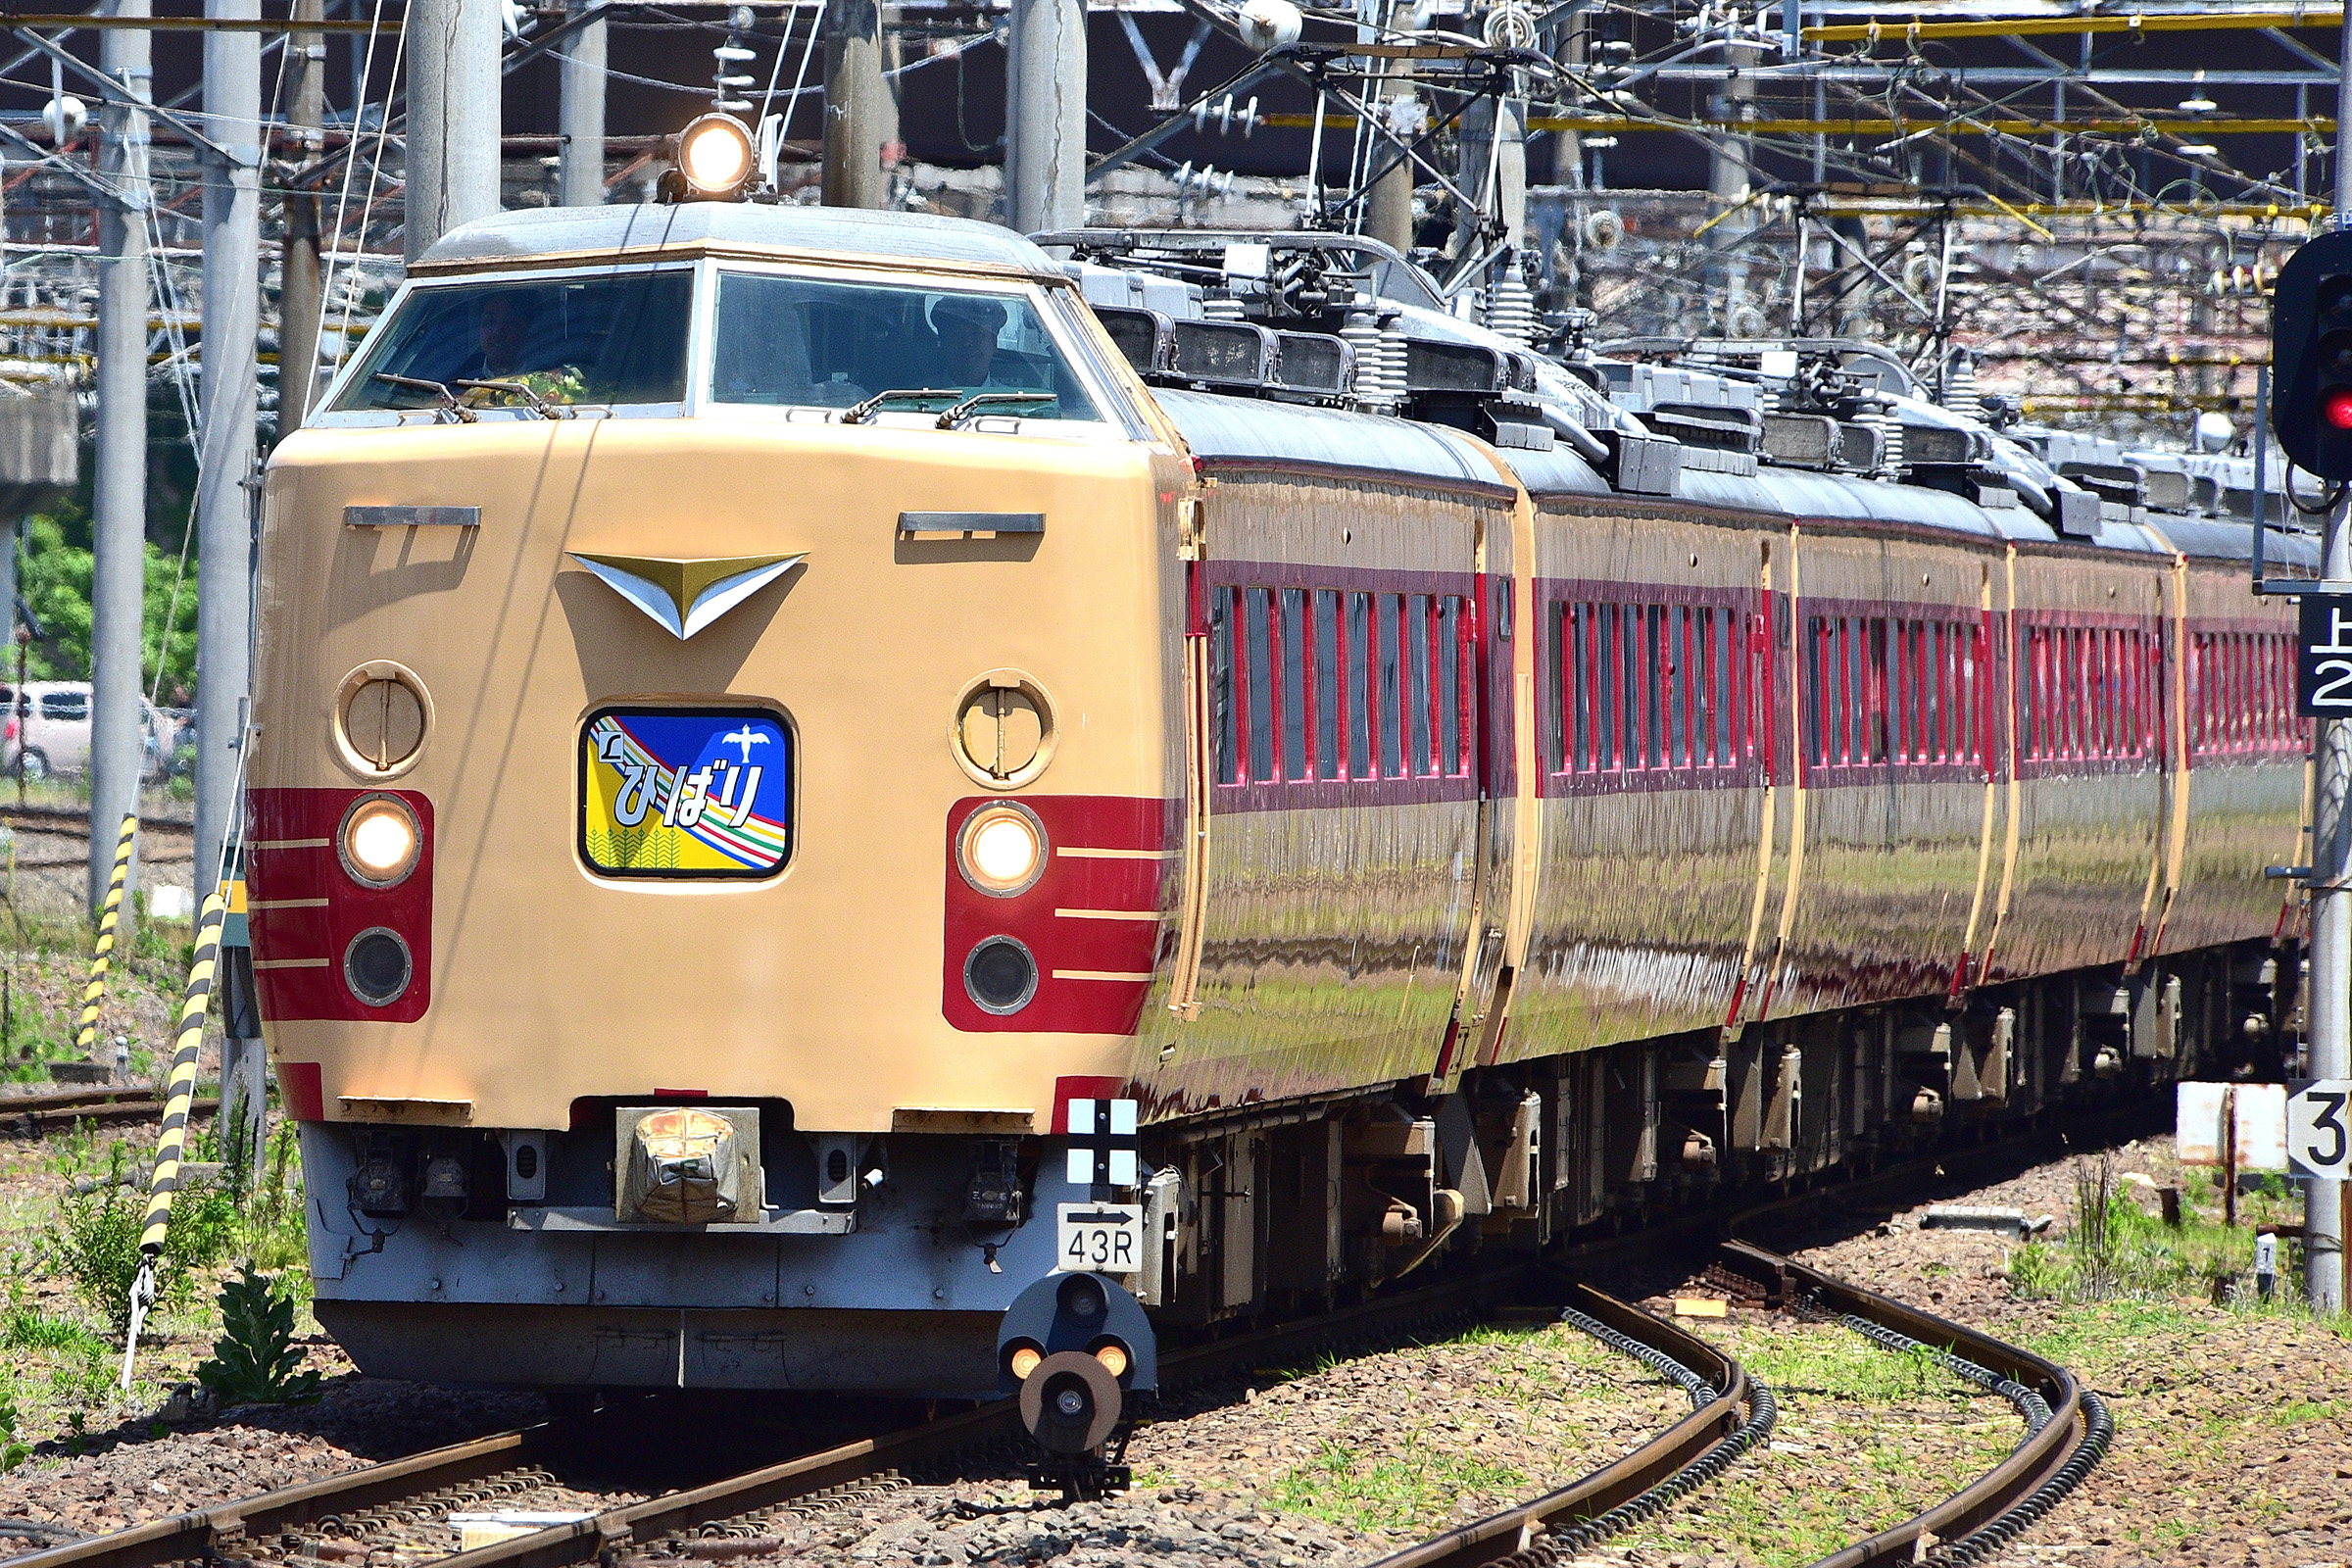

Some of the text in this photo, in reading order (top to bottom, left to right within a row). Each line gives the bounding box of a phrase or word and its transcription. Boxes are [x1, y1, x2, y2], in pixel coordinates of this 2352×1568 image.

[613, 759, 763, 828] ひばり
[2306, 1091, 2347, 1166] 3
[1067, 1229, 1133, 1265] 43R
